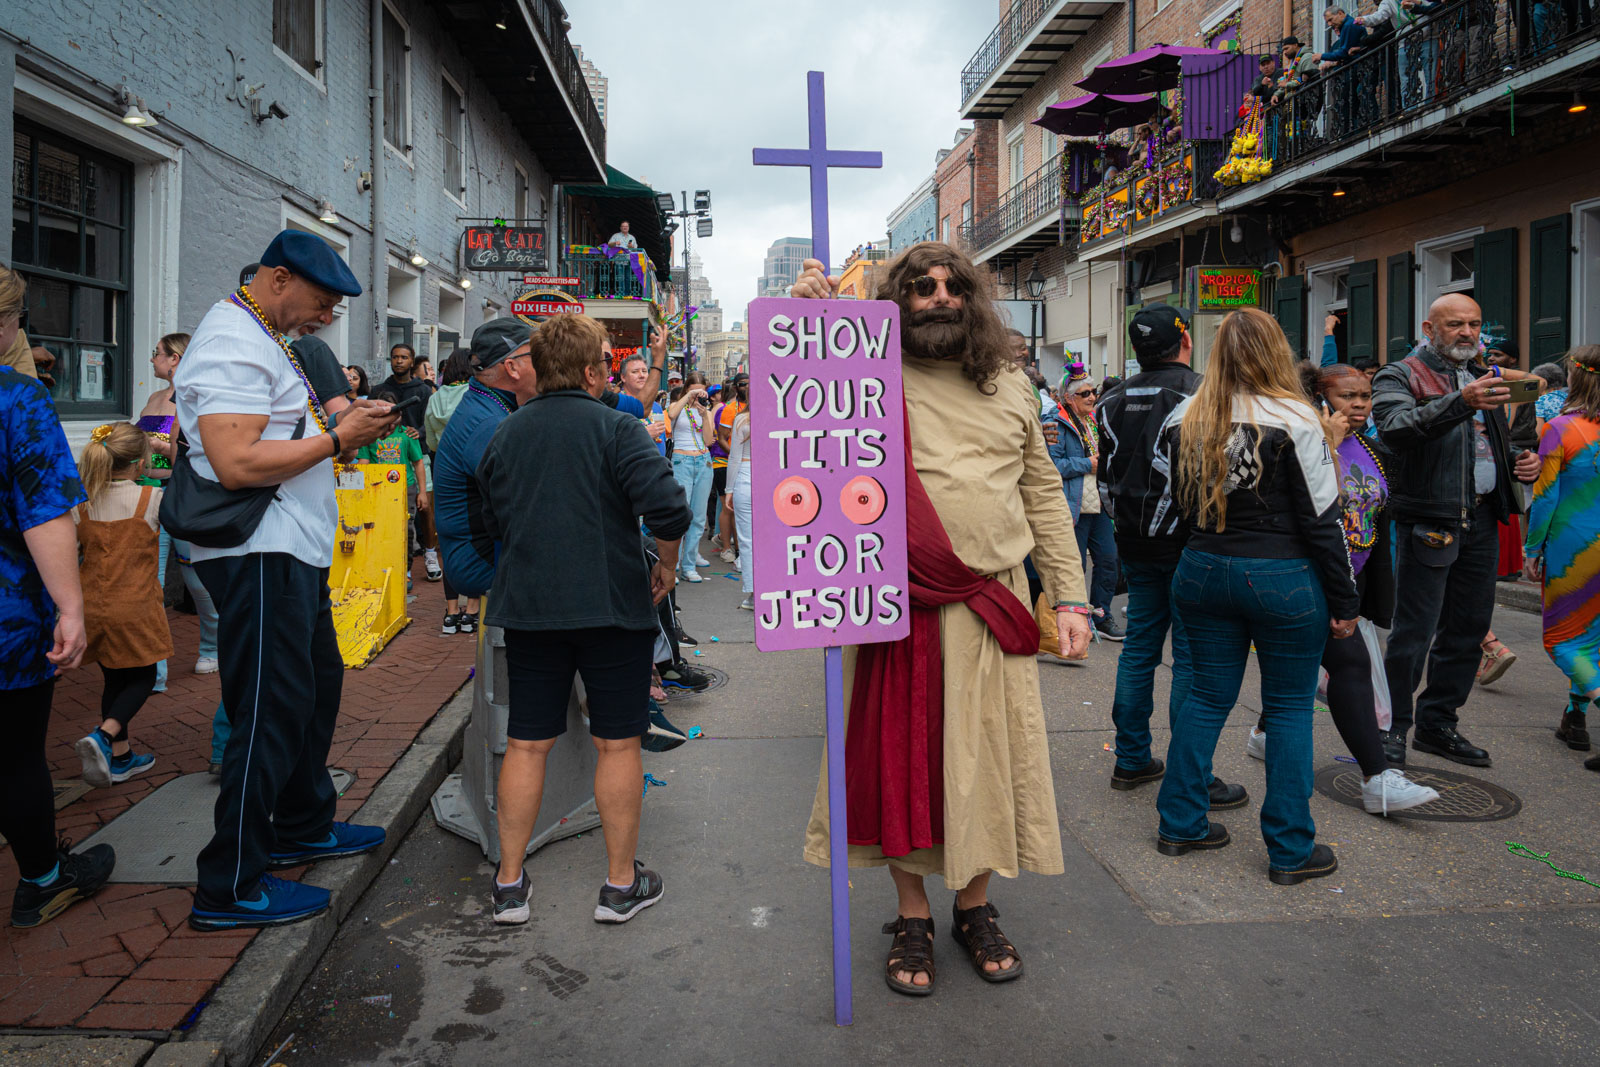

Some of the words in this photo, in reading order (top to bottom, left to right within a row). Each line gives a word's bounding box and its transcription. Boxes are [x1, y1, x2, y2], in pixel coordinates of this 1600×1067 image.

[504, 229, 543, 249] CATZ
[1200, 274, 1259, 285] TROPICAL
[1218, 286, 1243, 296] ISLE
[514, 303, 582, 314] DIXIELAND
[768, 314, 891, 360] SHOW
[768, 373, 886, 419] YOUR
[768, 428, 887, 469] TITS
[787, 532, 884, 576] FOR
[759, 584, 903, 630] JESUS
